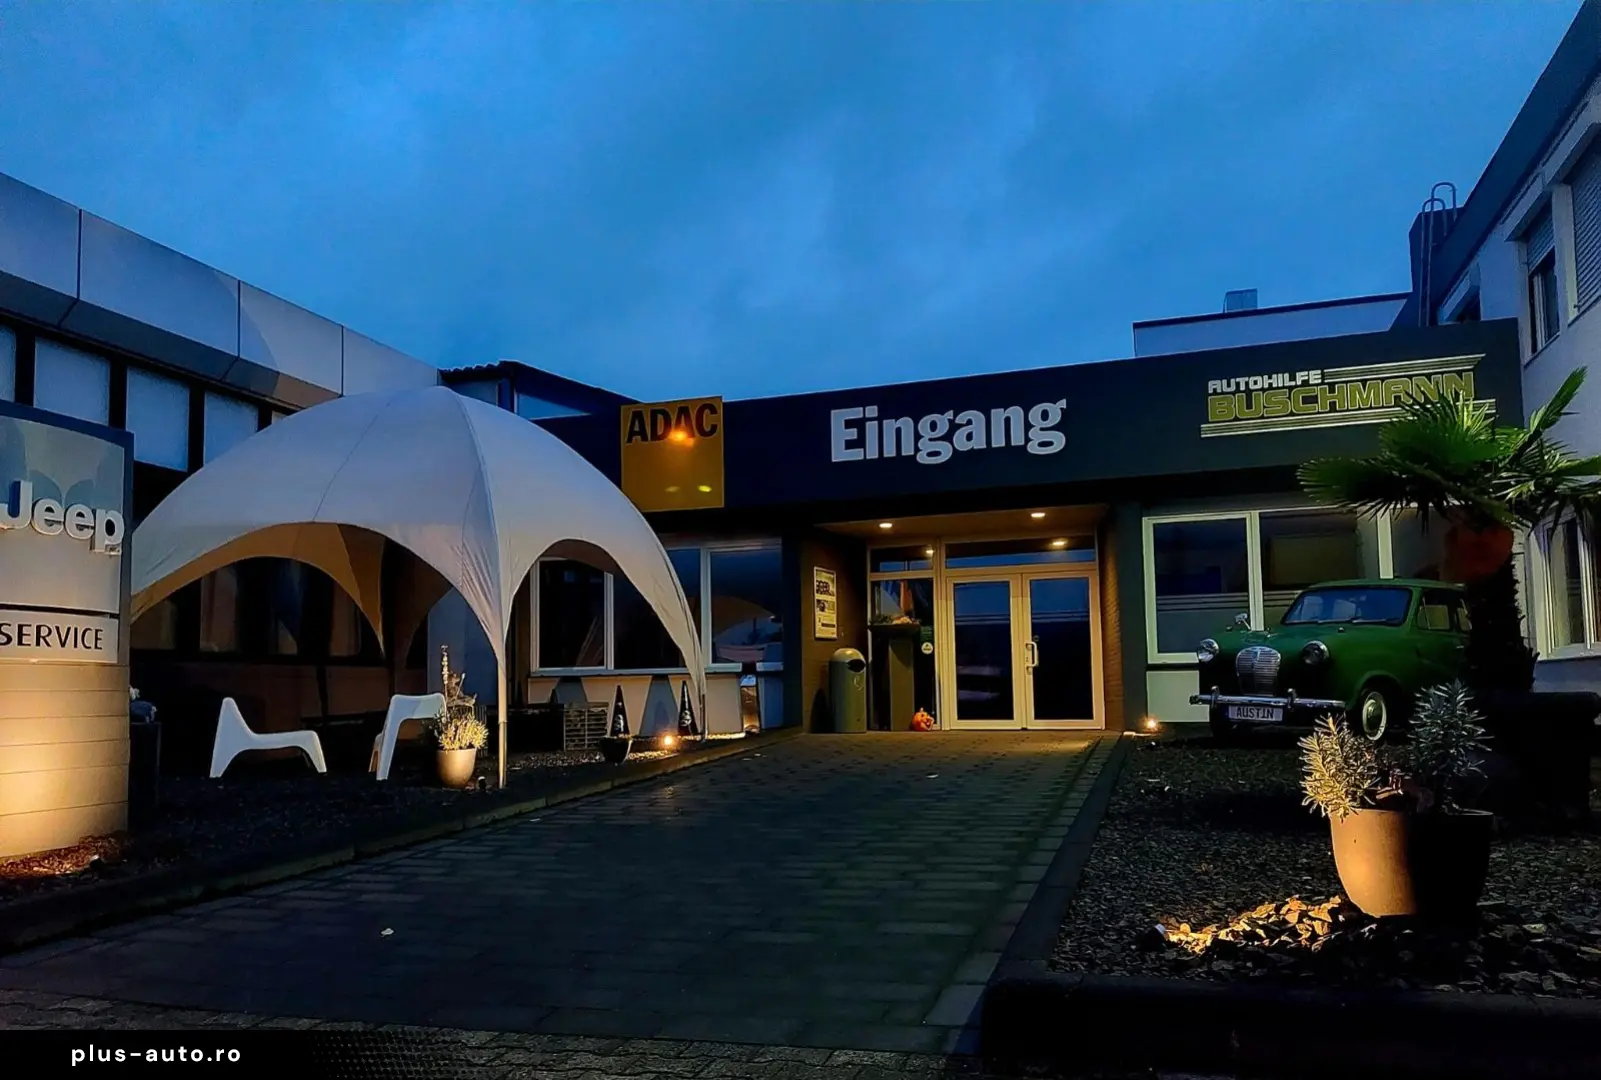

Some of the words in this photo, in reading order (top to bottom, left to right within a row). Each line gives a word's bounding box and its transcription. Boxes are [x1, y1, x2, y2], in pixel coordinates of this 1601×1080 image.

[1208, 370, 1322, 393] AUTOHILFE
[1208, 372, 1474, 421] BUSCHMANN
[626, 402, 718, 444] ADAC
[830, 398, 1067, 464] Eingang
[0, 480, 124, 553] Jeep
[0, 622, 103, 650] SERVICE
[1236, 707, 1274, 719] AUSTIN
